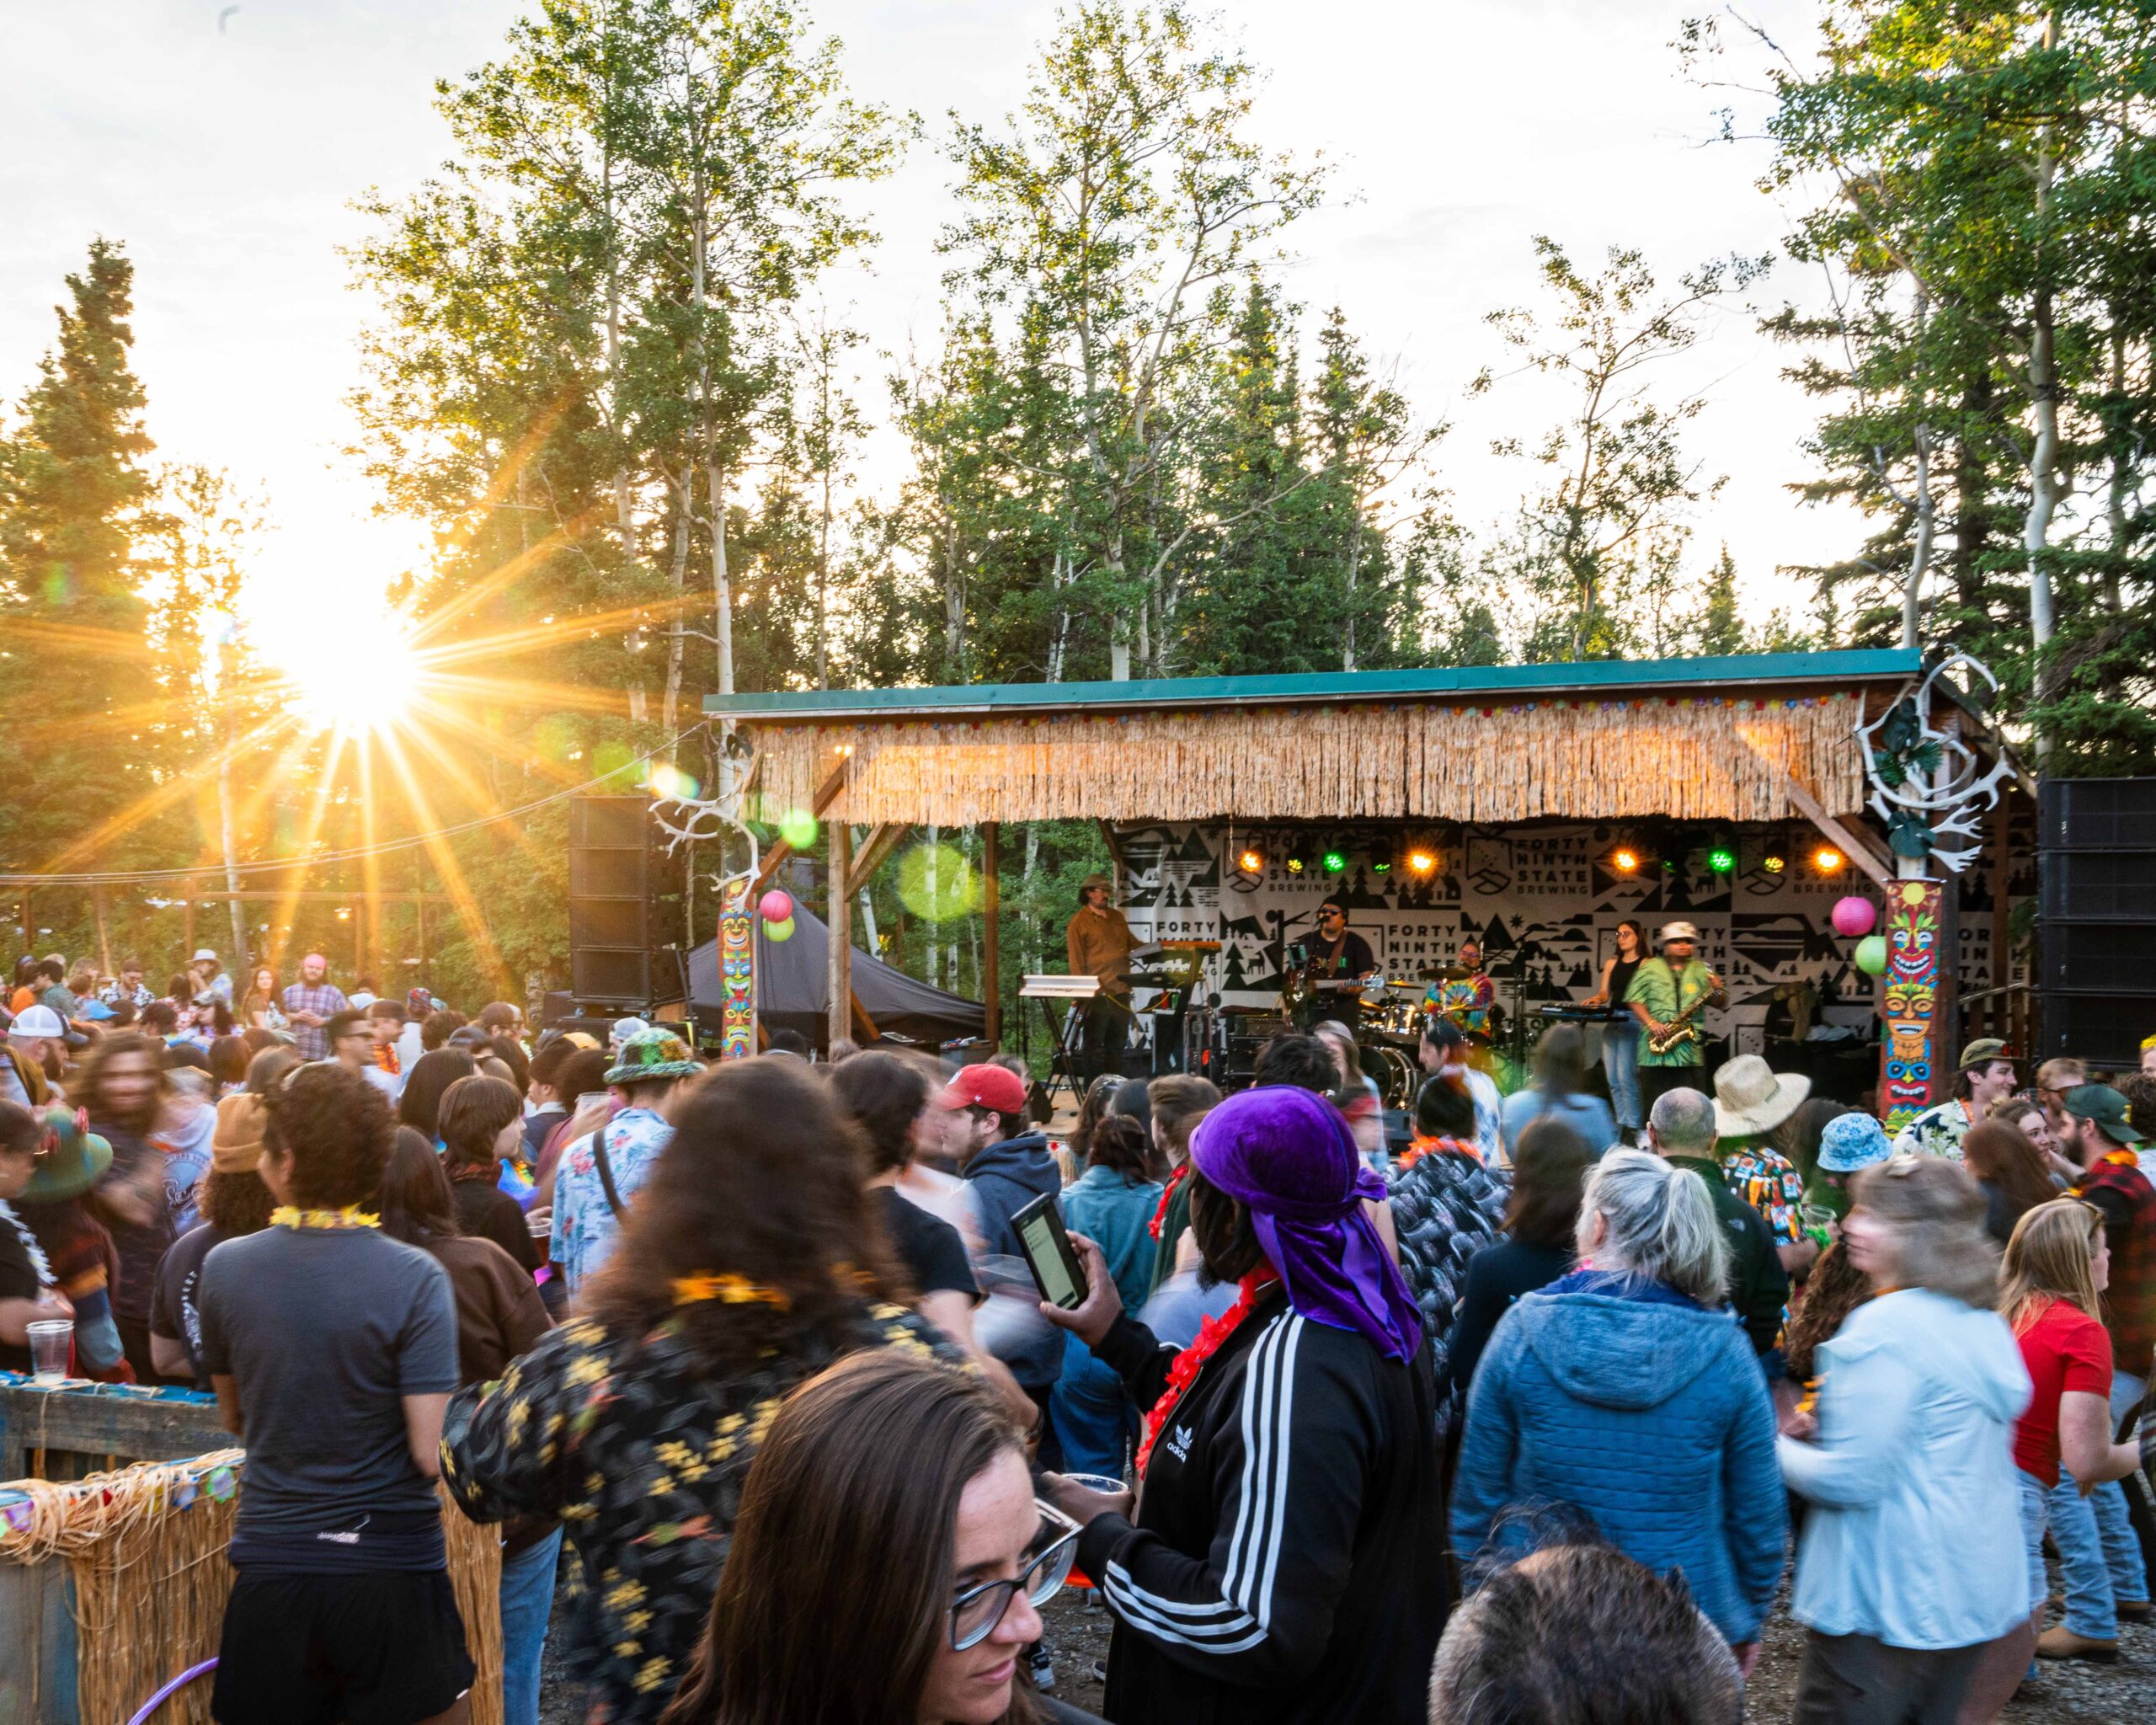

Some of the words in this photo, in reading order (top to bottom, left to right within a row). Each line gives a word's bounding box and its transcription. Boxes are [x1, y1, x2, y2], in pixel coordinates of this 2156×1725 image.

[1517, 837, 1588, 849] FORTY
[1517, 853, 1586, 865] NINTH
[1518, 870, 1587, 882] STATE
[1269, 884, 1331, 892] BREWING
[1517, 885, 1588, 895] BREWING
[1156, 921, 1215, 932] FORTY
[1389, 925, 1455, 937] FORTY
[1389, 941, 1455, 953] NINTH
[1389, 958, 1455, 969] STATE
